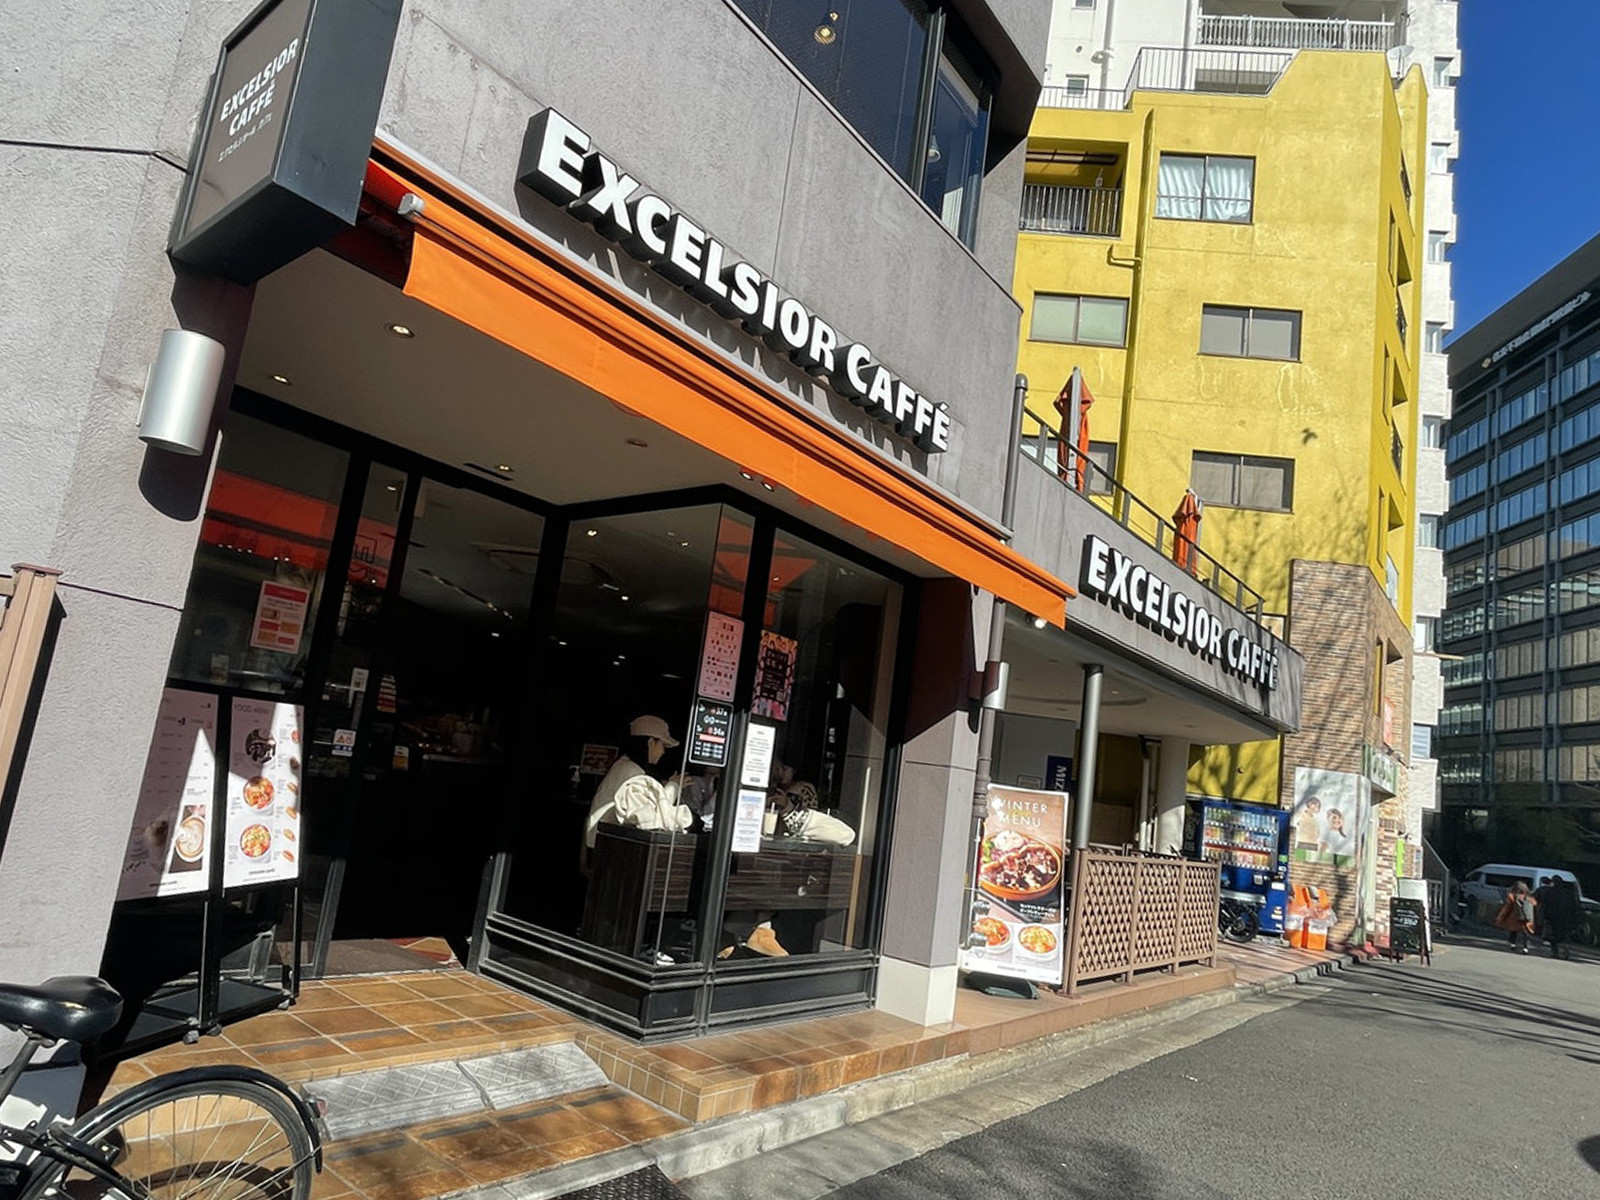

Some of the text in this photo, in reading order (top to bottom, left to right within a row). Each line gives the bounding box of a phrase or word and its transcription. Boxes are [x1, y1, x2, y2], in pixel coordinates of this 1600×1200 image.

[220, 38, 298, 121] EXCELSIOR
[229, 79, 275, 136] CAFFÉ
[537, 107, 950, 450] EXCELSIOR CAFFÉ
[1088, 536, 1279, 690] EXCELSIOR CAFFÉ
